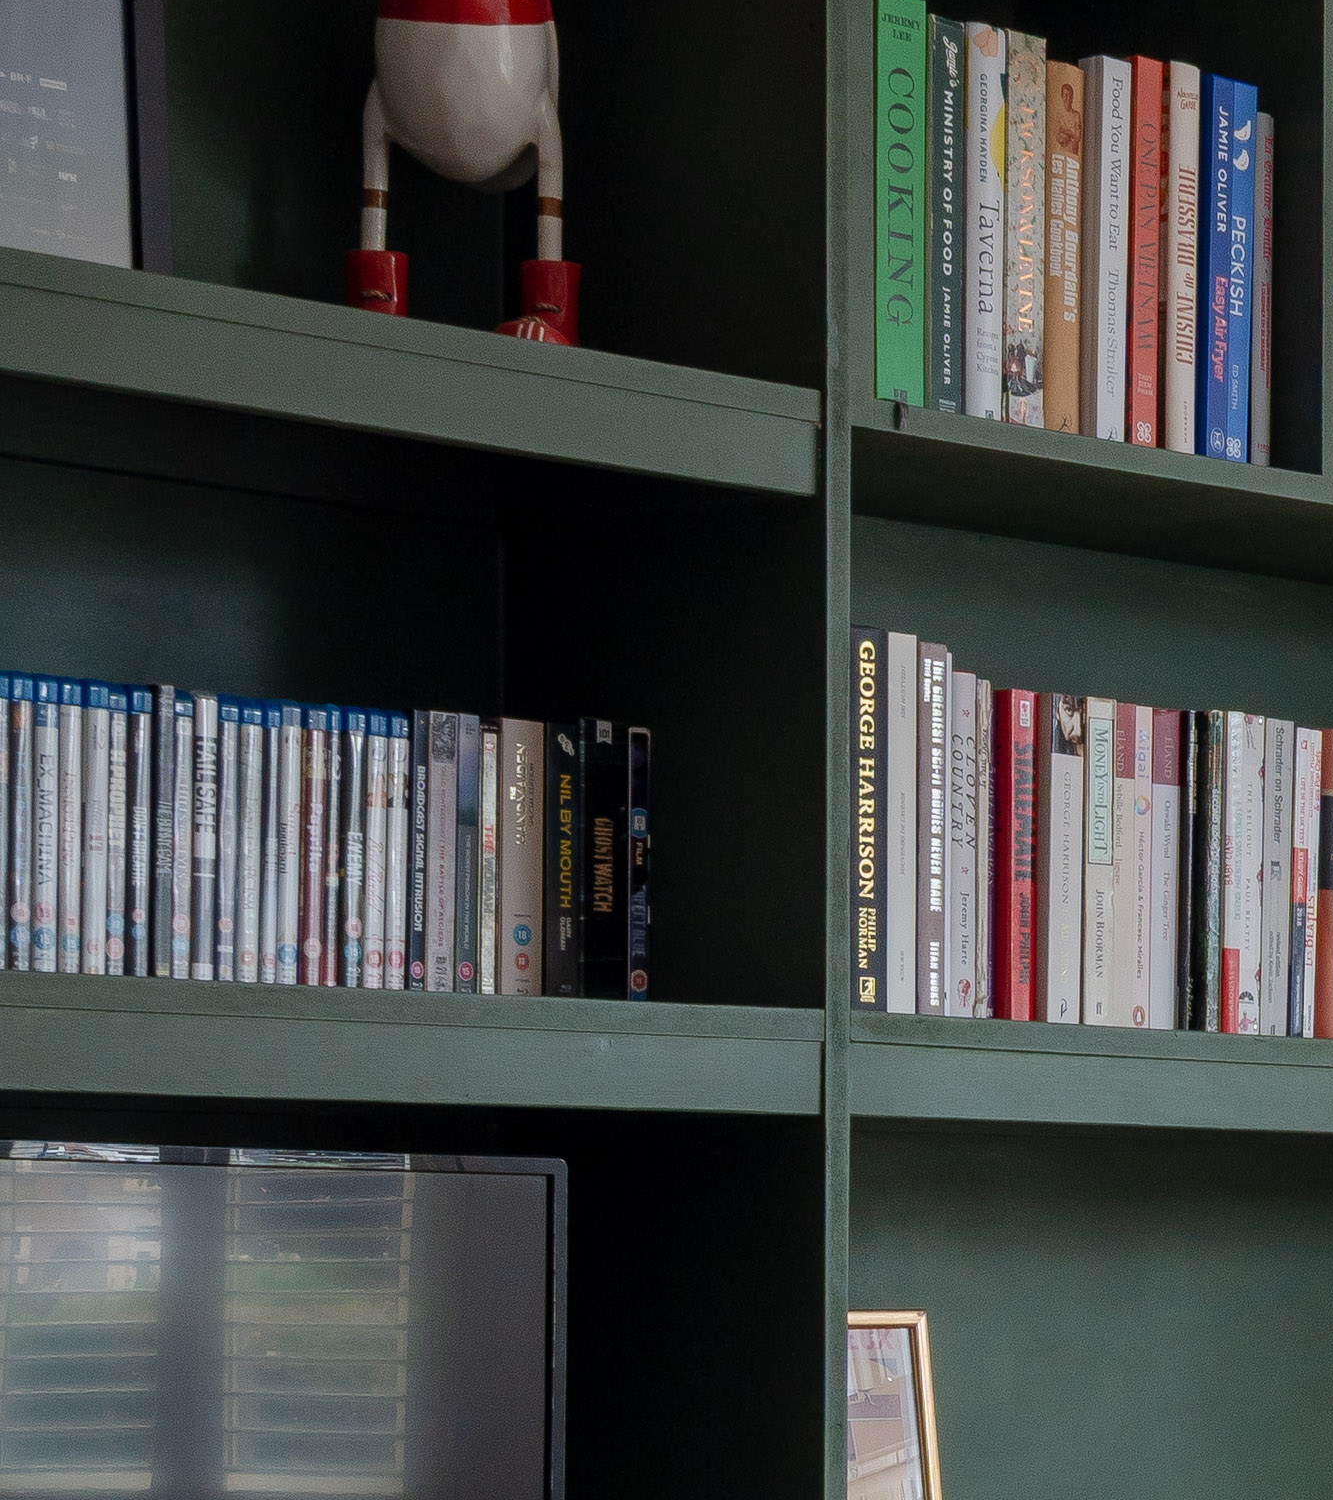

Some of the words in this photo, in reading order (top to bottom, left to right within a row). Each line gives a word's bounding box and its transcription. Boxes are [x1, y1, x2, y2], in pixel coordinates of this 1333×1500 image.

[882, 12, 921, 30] JEREMY
[892, 29, 911, 42] LEE
[943, 36, 960, 88] Jamie's
[979, 73, 988, 133] GEORGINA
[1111, 77, 1123, 119] Food
[943, 90, 953, 183] MINISTRY
[1110, 123, 1123, 154] You
[1218, 106, 1229, 161] JAMIE
[979, 136, 988, 183] HAYDEN
[1110, 158, 1122, 198] Want
[887, 67, 915, 327] COOKING
[943, 185, 953, 213] OF
[1110, 200, 1119, 219] to
[1176, 164, 1196, 267] BRASSERIE
[1217, 169, 1228, 233] OLIVER
[943, 219, 953, 276] FOOD
[978, 200, 1000, 315] Taverna
[1109, 224, 1120, 251] Eat
[1184, 273, 1194, 289] de
[1229, 215, 1247, 317] PECKISH
[942, 286, 951, 328] JAMIE
[1105, 269, 1118, 334] Thomas
[1212, 275, 1229, 316] Easy
[1176, 291, 1194, 365] CUISINE
[1214, 318, 1229, 340] Air
[943, 333, 951, 385] OLIVER
[1106, 338, 1117, 397] Straker
[1212, 341, 1228, 383] Fryer
[859, 640, 876, 750] GEORGE
[932, 660, 945, 683] THE
[931, 685, 945, 743] GREATEST
[931, 747, 945, 786] SCI-FI
[1274, 727, 1284, 772] Schrader
[416, 765, 426, 833] BROADCAST
[560, 774, 571, 804] NIL
[950, 735, 964, 849] COUNTRY
[966, 736, 977, 850] CLOVEN
[1275, 779, 1282, 793] on
[560, 809, 571, 835] BY
[858, 757, 875, 900] HARRISON
[930, 788, 944, 834] MOVIES
[1273, 794, 1283, 844] Schrader
[348, 832, 363, 885] ENEMY
[415, 836, 425, 878] SIGNAL
[560, 840, 571, 908] MOUTH
[593, 818, 613, 912] GHOSTWATCH
[929, 837, 944, 874] NEVER
[414, 880, 424, 932] INTRUSION
[929, 878, 943, 912] MADE
[959, 892, 970, 930] Jeremy
[1096, 888, 1105, 918] JOHN
[858, 907, 868, 969] NORMAN
[867, 908, 877, 952] PHILIP
[960, 934, 969, 965] Harte
[1095, 921, 1105, 979] BOORMAN
